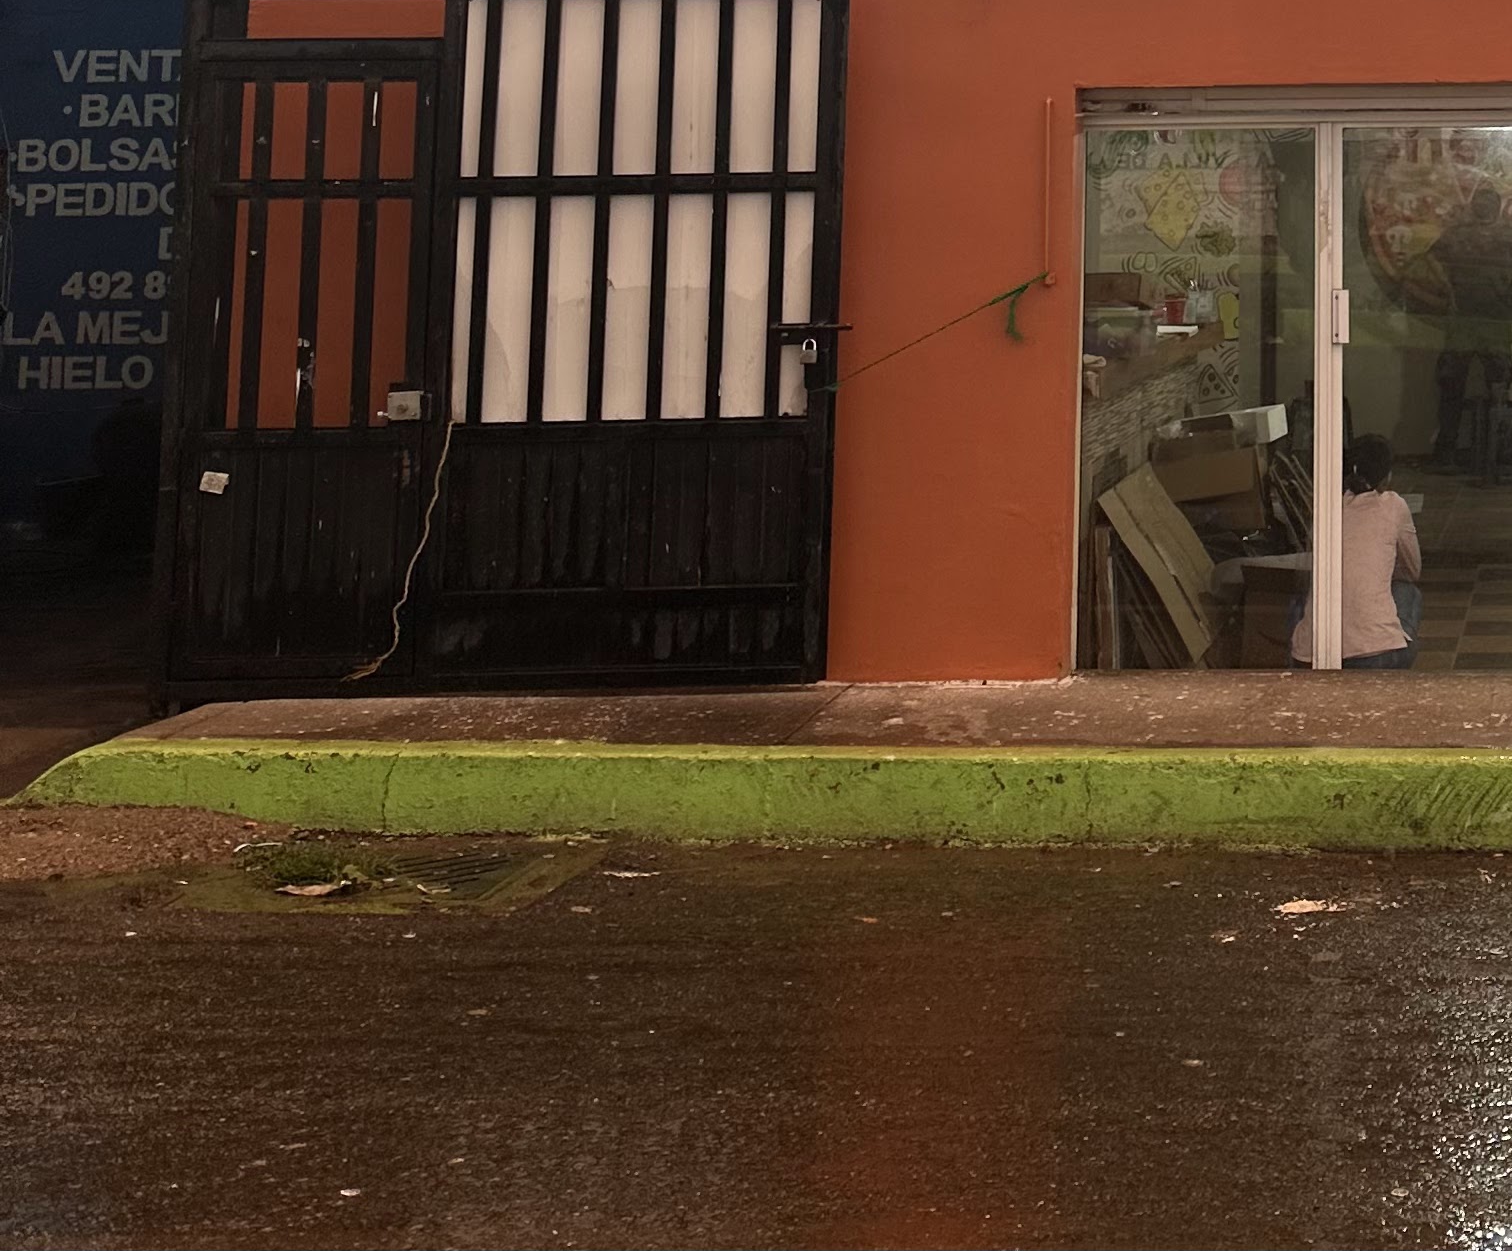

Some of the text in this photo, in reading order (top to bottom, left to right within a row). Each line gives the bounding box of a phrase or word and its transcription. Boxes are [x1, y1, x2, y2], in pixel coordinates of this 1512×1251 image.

[53, 49, 182, 84] VENT
[79, 93, 180, 128] BAR
[61, 271, 171, 301] 492 8
[3, 311, 65, 346] LA
[17, 355, 154, 390] HIELO
